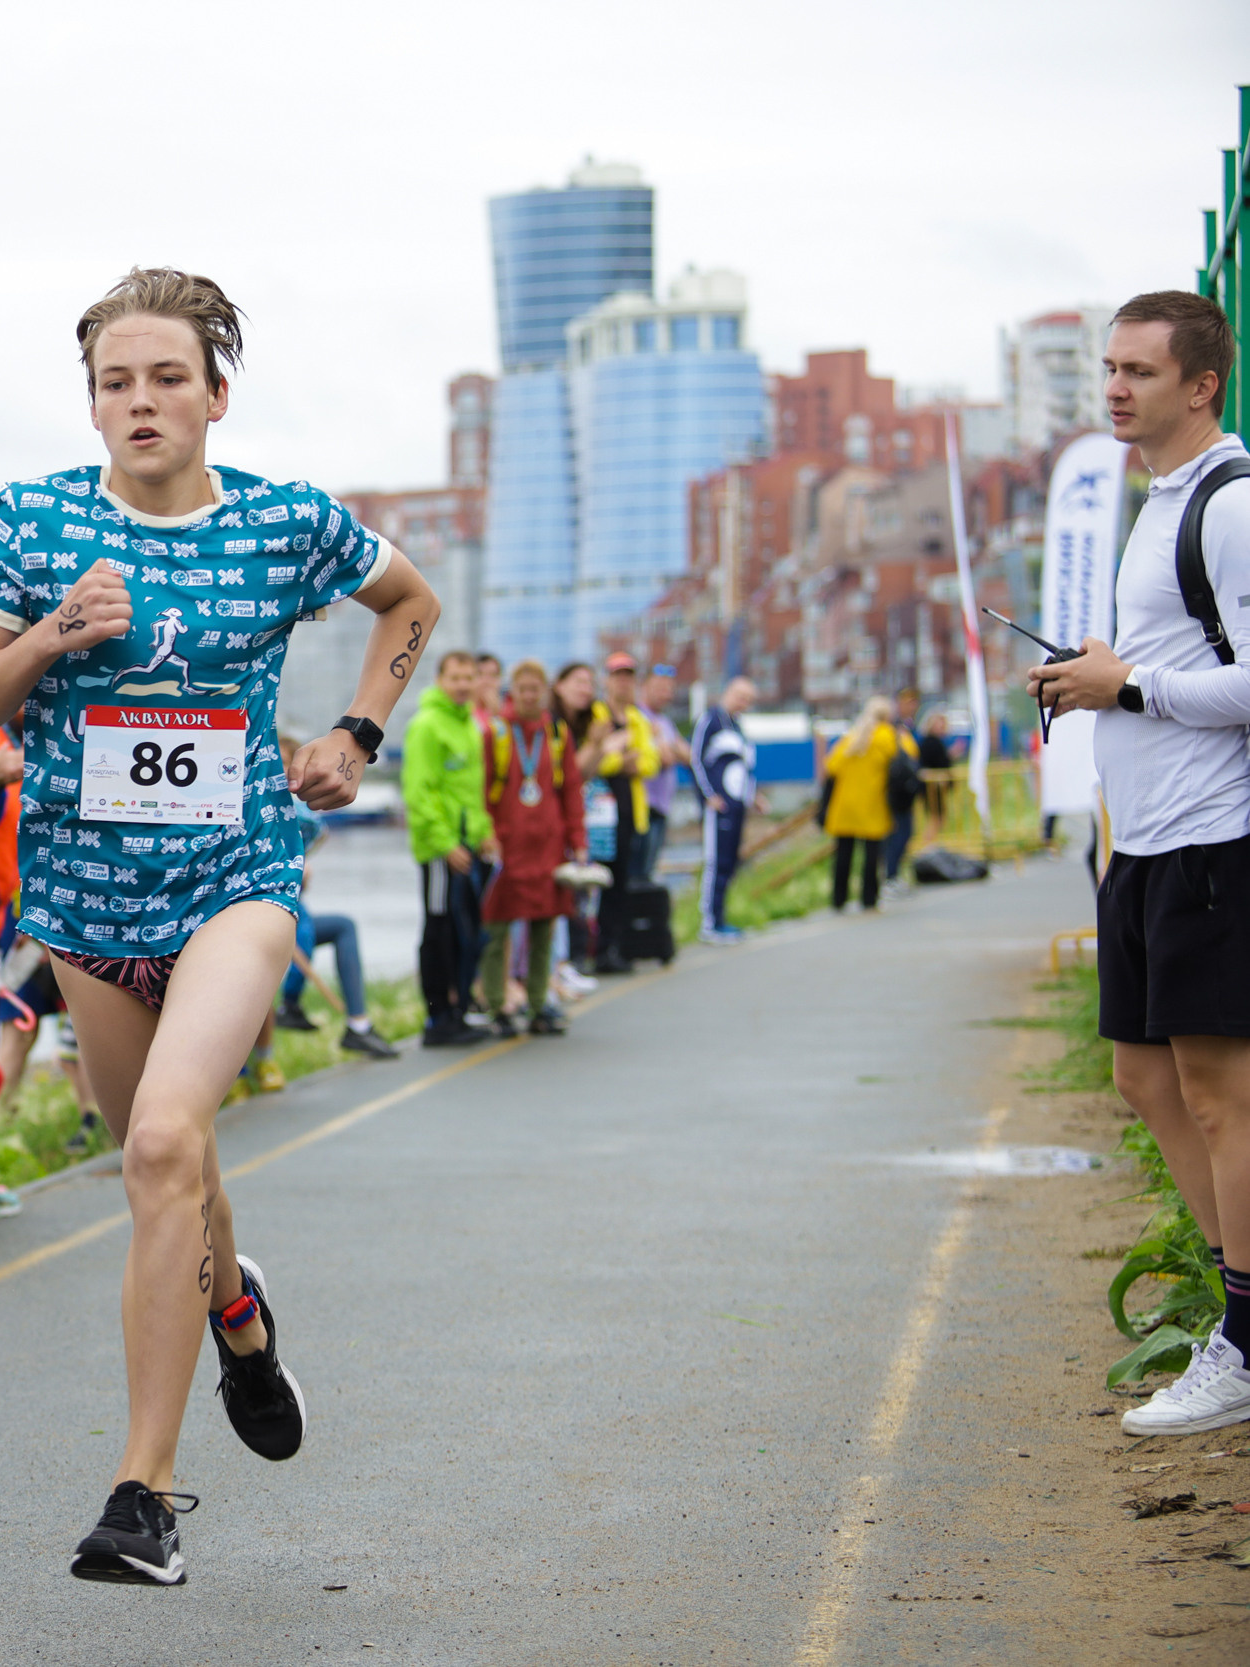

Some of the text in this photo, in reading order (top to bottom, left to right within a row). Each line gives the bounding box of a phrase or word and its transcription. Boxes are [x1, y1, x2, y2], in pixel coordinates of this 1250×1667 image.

[268, 513, 287, 521] TEAM
[62, 531, 95, 539] TRIATHLON
[58, 603, 86, 635] 86
[390, 621, 423, 680] 86
[118, 711, 213, 728] АКВАТЛОН
[130, 742, 198, 787] 86
[337, 752, 354, 781] 86
[34, 915, 48, 926] TEAM
